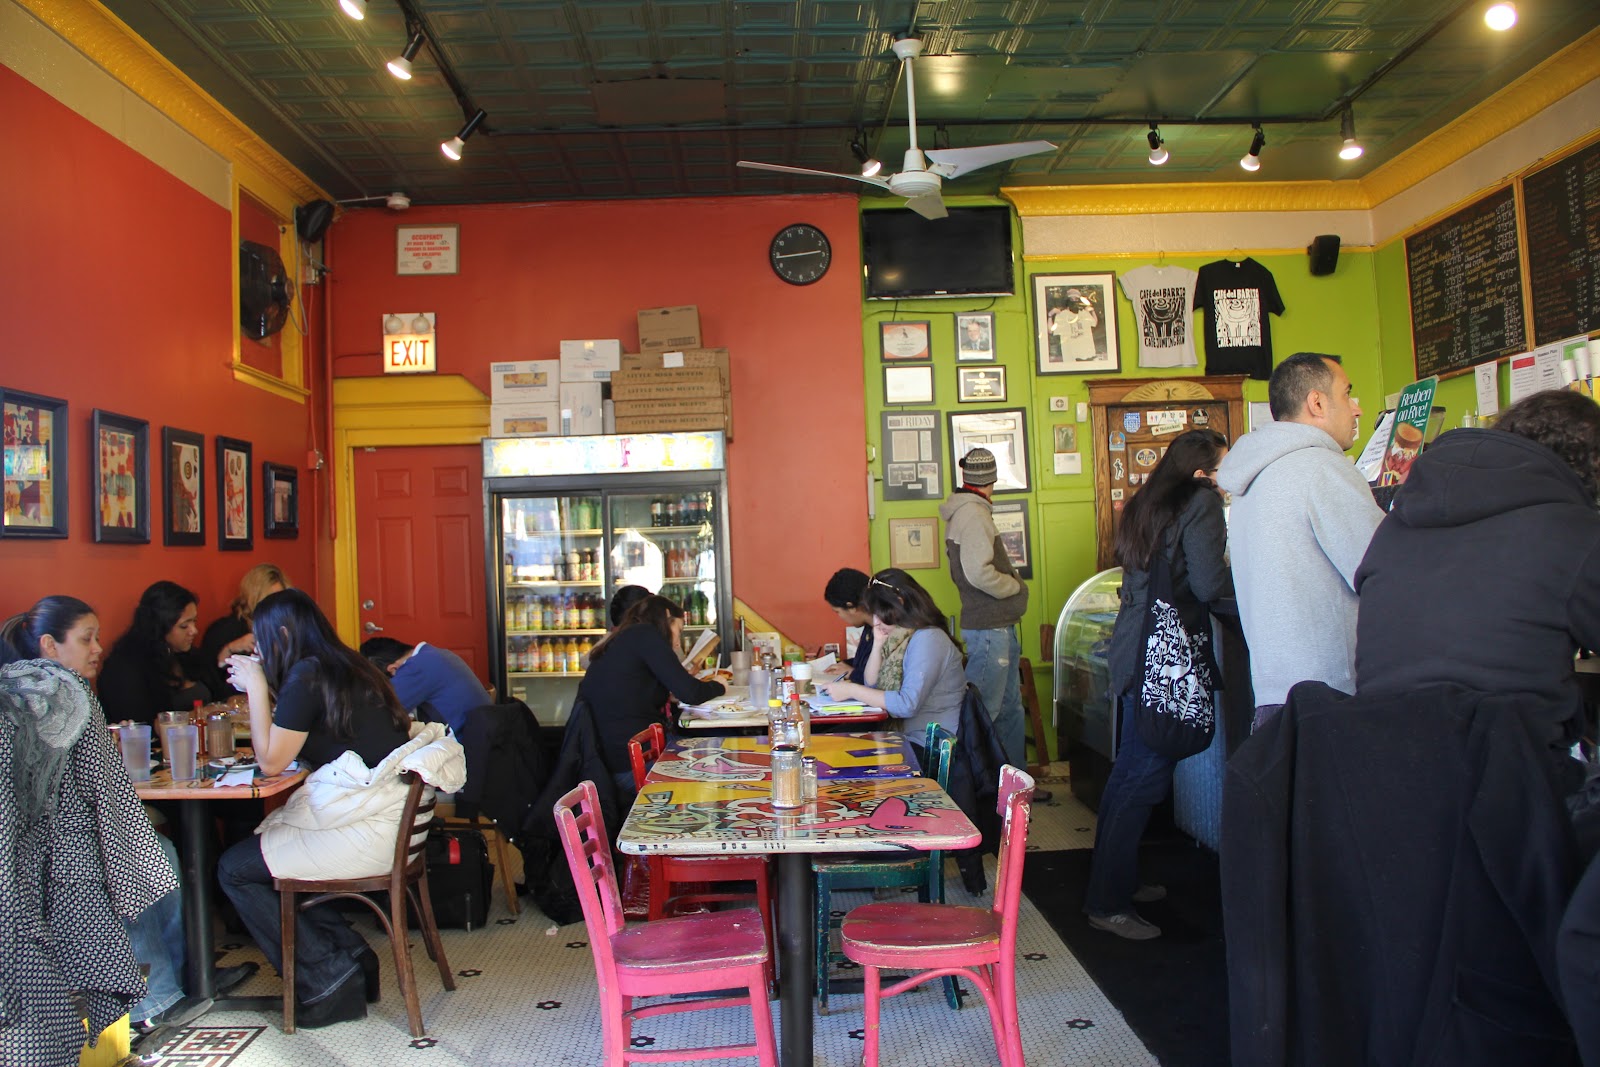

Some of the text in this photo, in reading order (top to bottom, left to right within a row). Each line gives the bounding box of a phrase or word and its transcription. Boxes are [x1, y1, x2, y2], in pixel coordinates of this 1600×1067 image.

[392, 340, 429, 366] EXIT
[1401, 388, 1432, 407] Reuben
[1398, 402, 1428, 422] on Rye!
[900, 417, 932, 427] FRIDAY
